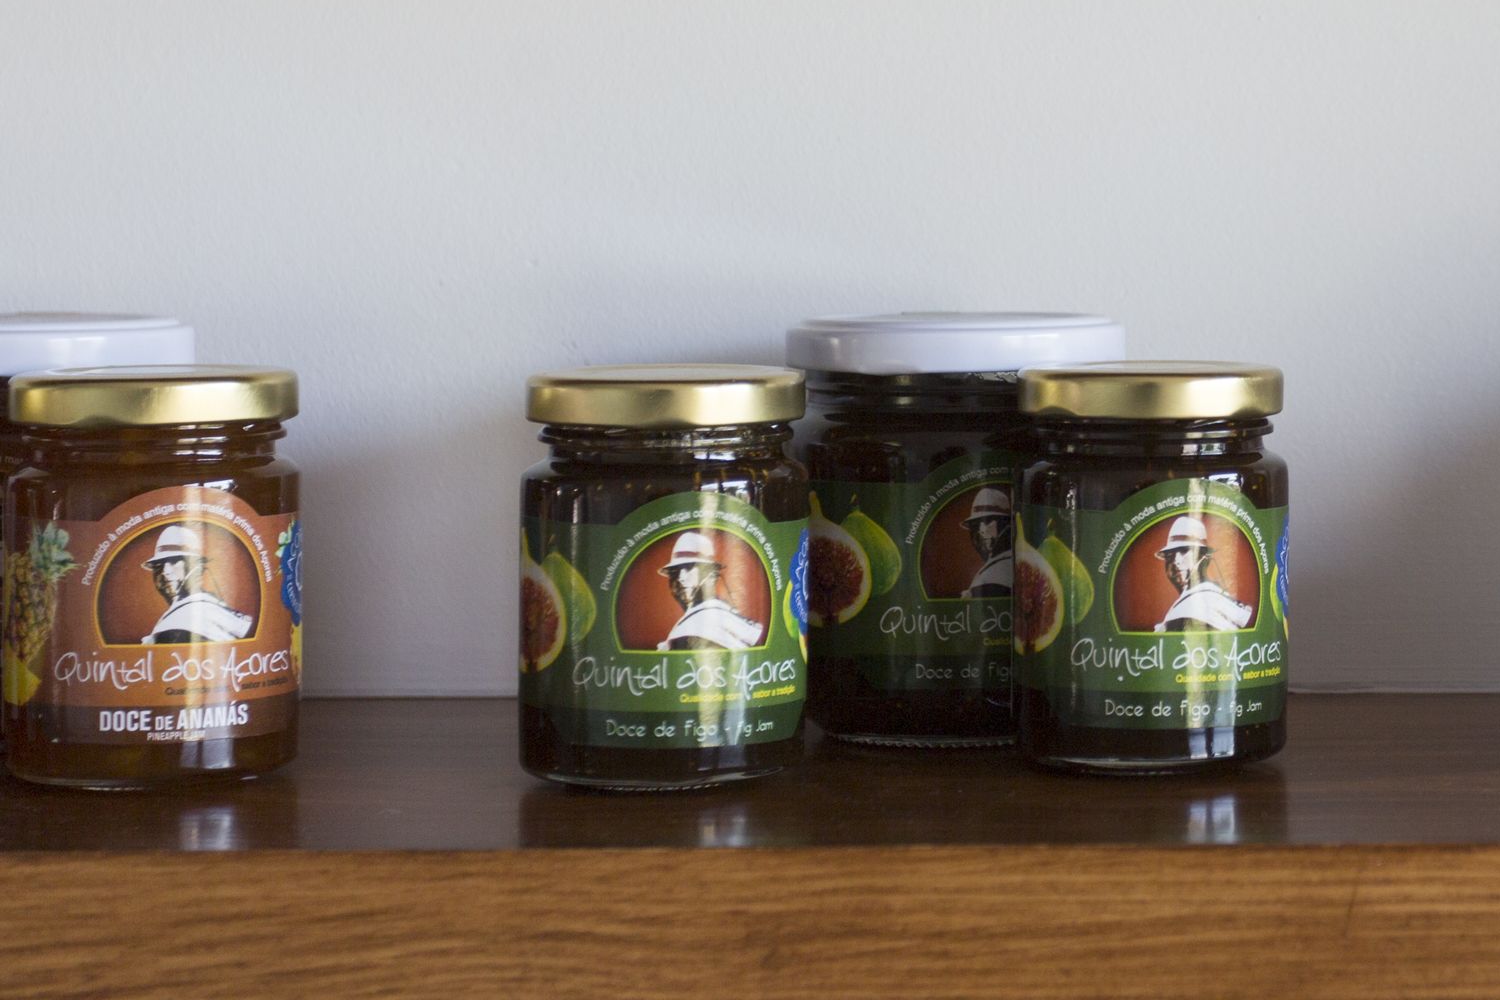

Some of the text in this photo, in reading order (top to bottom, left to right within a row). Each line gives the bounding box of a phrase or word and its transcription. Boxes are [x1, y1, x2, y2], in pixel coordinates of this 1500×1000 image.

[81, 540, 110, 585] Produzido
[115, 515, 142, 536] moda
[143, 504, 174, 520] antiga
[905, 502, 931, 545] Produzido
[1098, 529, 1125, 575] Produzido
[1131, 505, 1156, 526] moda
[1156, 495, 1185, 510] antiga
[1236, 508, 1255, 529] prima
[879, 604, 971, 641] Quintal
[54, 647, 289, 692] Quintal dos Açores
[572, 655, 796, 701] Quintal dos Açores
[915, 663, 980, 680] Doce de
[1070, 636, 1281, 681] Quintal dos Açores
[100, 701, 249, 732] DOCE DE ANANÁS
[606, 719, 647, 737] Doce
[654, 720, 675, 737] de
[755, 719, 774, 732] Jam
[1105, 700, 1143, 717] Doce
[1152, 701, 1172, 717] de
[1246, 700, 1262, 712] Jam
